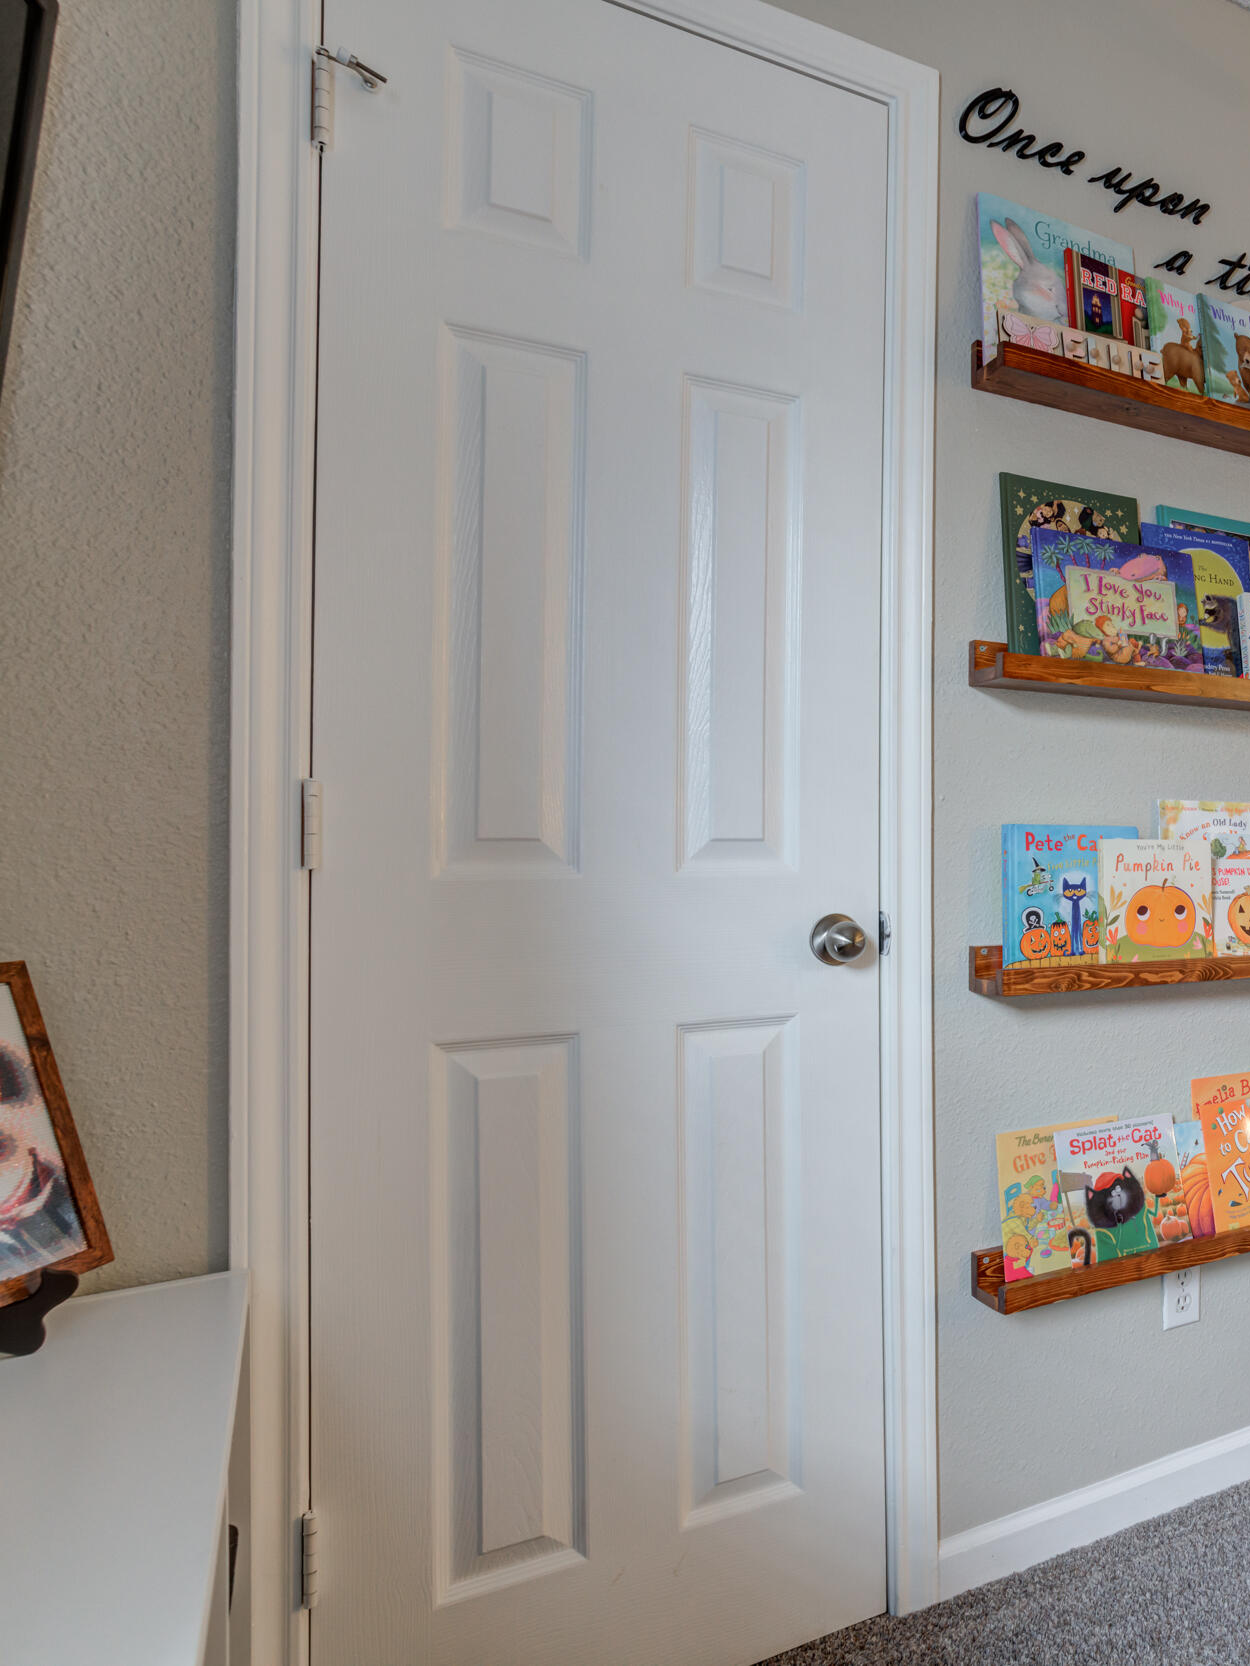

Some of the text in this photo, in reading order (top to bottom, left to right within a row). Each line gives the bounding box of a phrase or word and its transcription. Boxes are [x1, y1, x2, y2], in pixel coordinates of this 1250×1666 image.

[958, 87, 1211, 225] Once upon
[1034, 220, 1117, 268] Grandma
[1153, 250, 1193, 276] a
[1079, 266, 1118, 297] RED
[1158, 289, 1196, 317] Why a
[1208, 303, 1236, 331] Why
[1238, 318, 1247, 328] a
[1080, 573, 1094, 593] I
[1098, 575, 1130, 599] Love
[1085, 597, 1169, 628] Stinky Face
[1212, 818, 1226, 828] Old
[1228, 818, 1248, 832] Lady
[1024, 831, 1064, 852] Pete
[1076, 833, 1103, 852] Ca
[1115, 851, 1201, 882] Pumpkin Pie
[1217, 867, 1246, 877] PUMPKIN
[1215, 1103, 1246, 1137] How
[1015, 1135, 1032, 1148] The
[1068, 1133, 1118, 1156] Splat
[1131, 1126, 1163, 1144] Cat
[1219, 1141, 1232, 1156] to
[1012, 1151, 1047, 1174] Give
